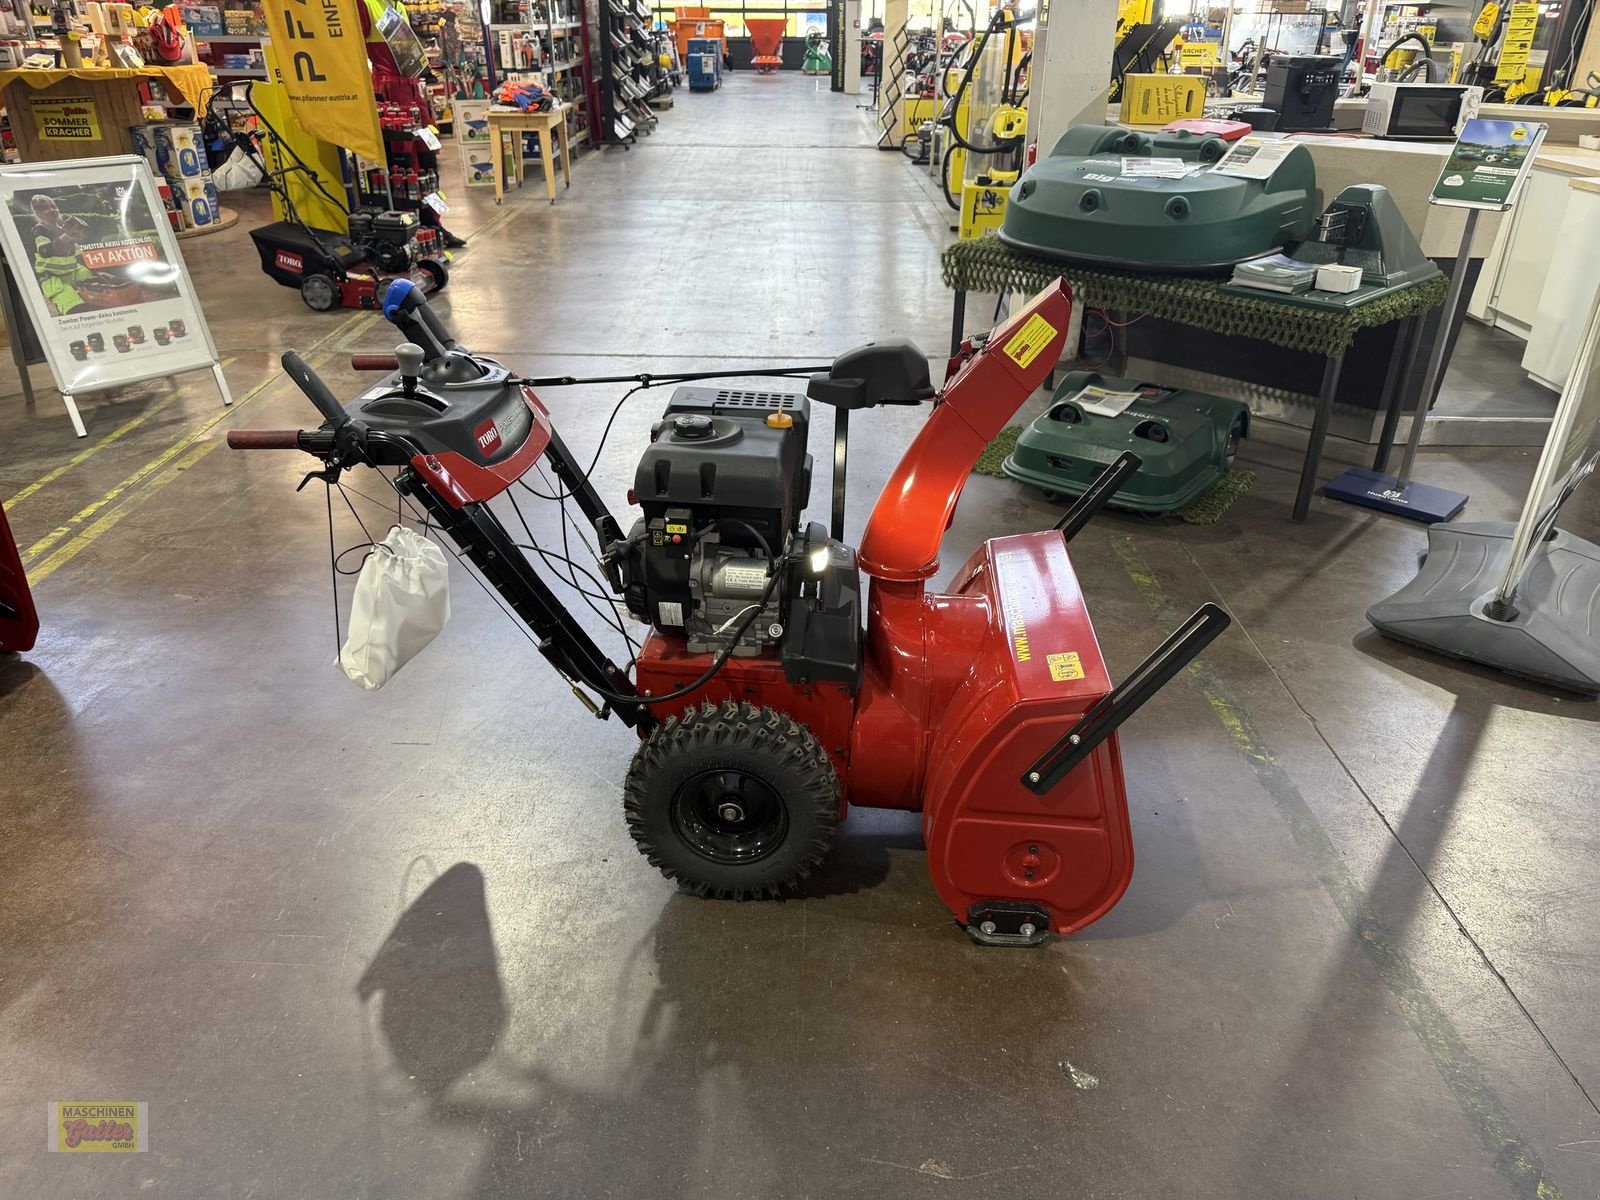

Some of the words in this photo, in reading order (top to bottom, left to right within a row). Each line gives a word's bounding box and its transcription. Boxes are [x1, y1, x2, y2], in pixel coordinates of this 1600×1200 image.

[284, 0, 326, 82] PF
[43, 117, 88, 126] SOMMER
[46, 128, 91, 136] KRACHER
[80, 242, 105, 251] ZWEITER
[105, 240, 121, 248] AKKU
[121, 236, 153, 246] KOSTENLOS
[86, 252, 106, 265] 1+1
[108, 246, 153, 263] AKTION
[58, 316, 78, 325] Zweiter
[477, 427, 499, 449] TORO
